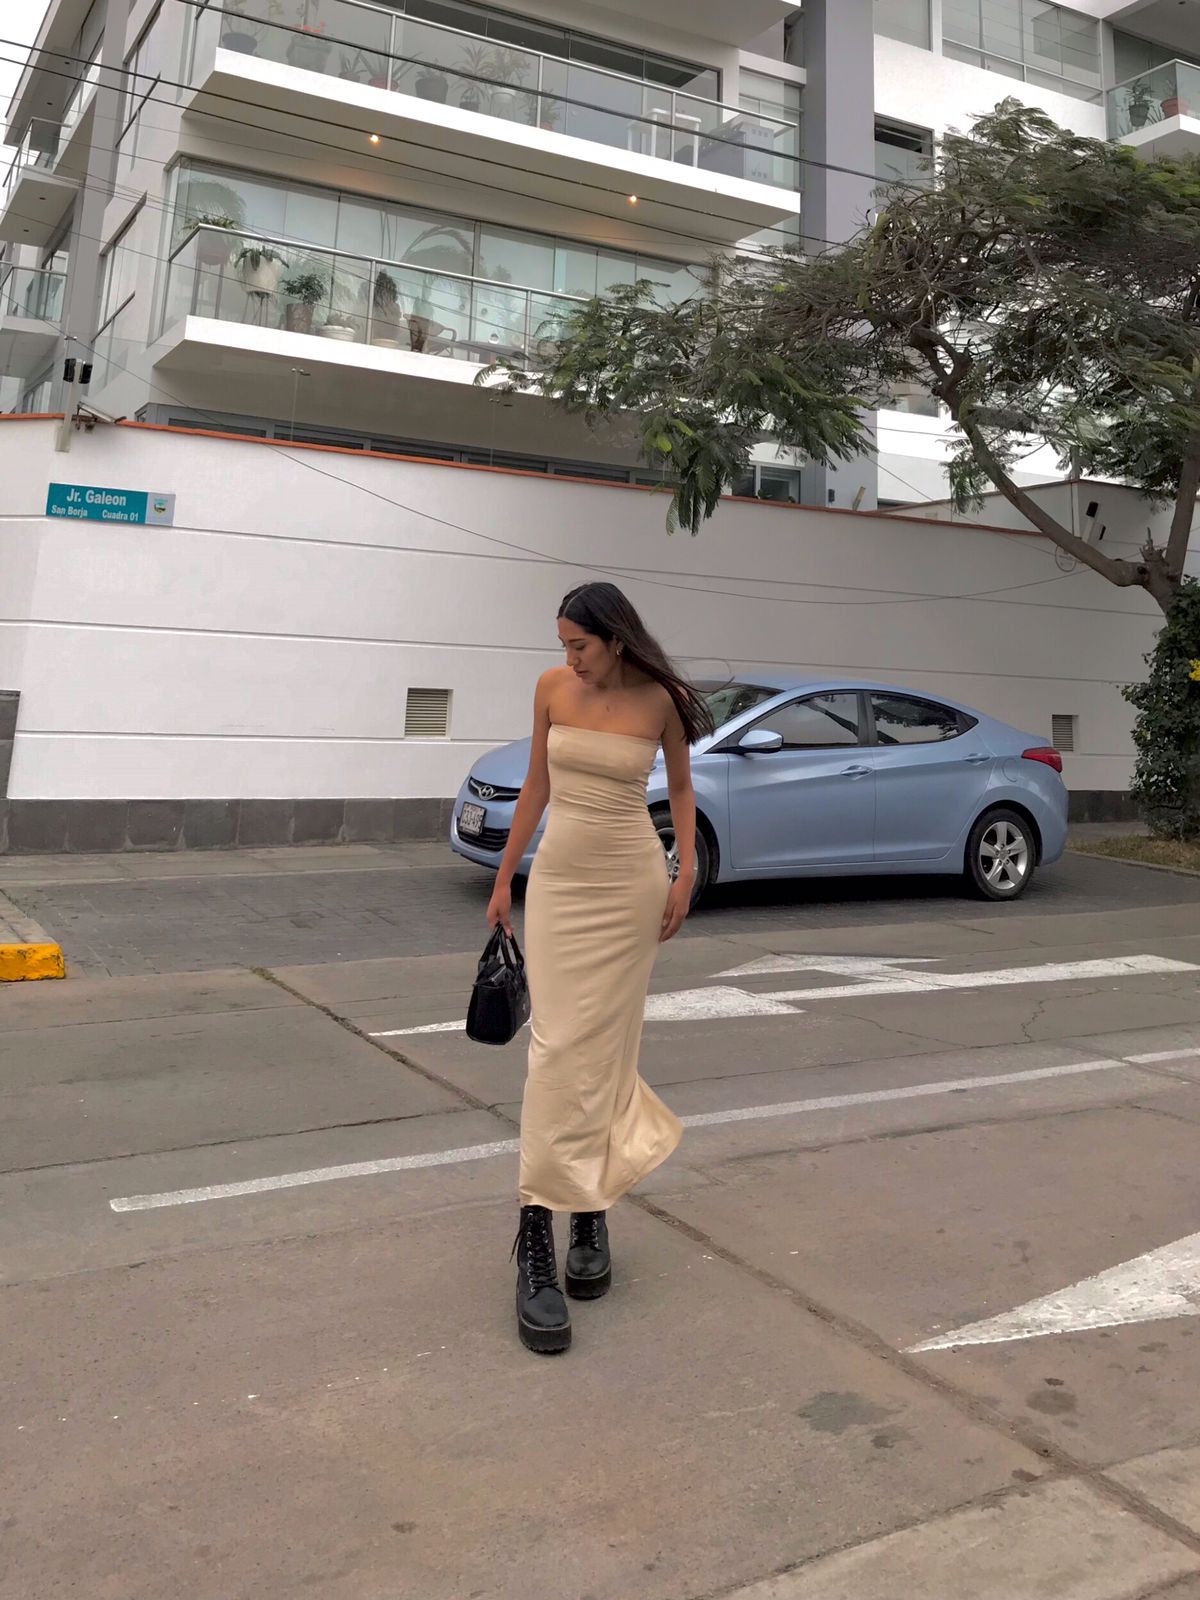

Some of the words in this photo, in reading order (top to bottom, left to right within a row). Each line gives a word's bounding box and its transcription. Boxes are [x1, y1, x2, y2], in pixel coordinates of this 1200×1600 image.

[66, 488, 81, 502] Jr.
[85, 489, 127, 506] Galeon
[51, 505, 65, 515] San
[67, 506, 88, 518] Borja
[102, 509, 128, 520] Cuadra
[129, 512, 139, 521] 01
